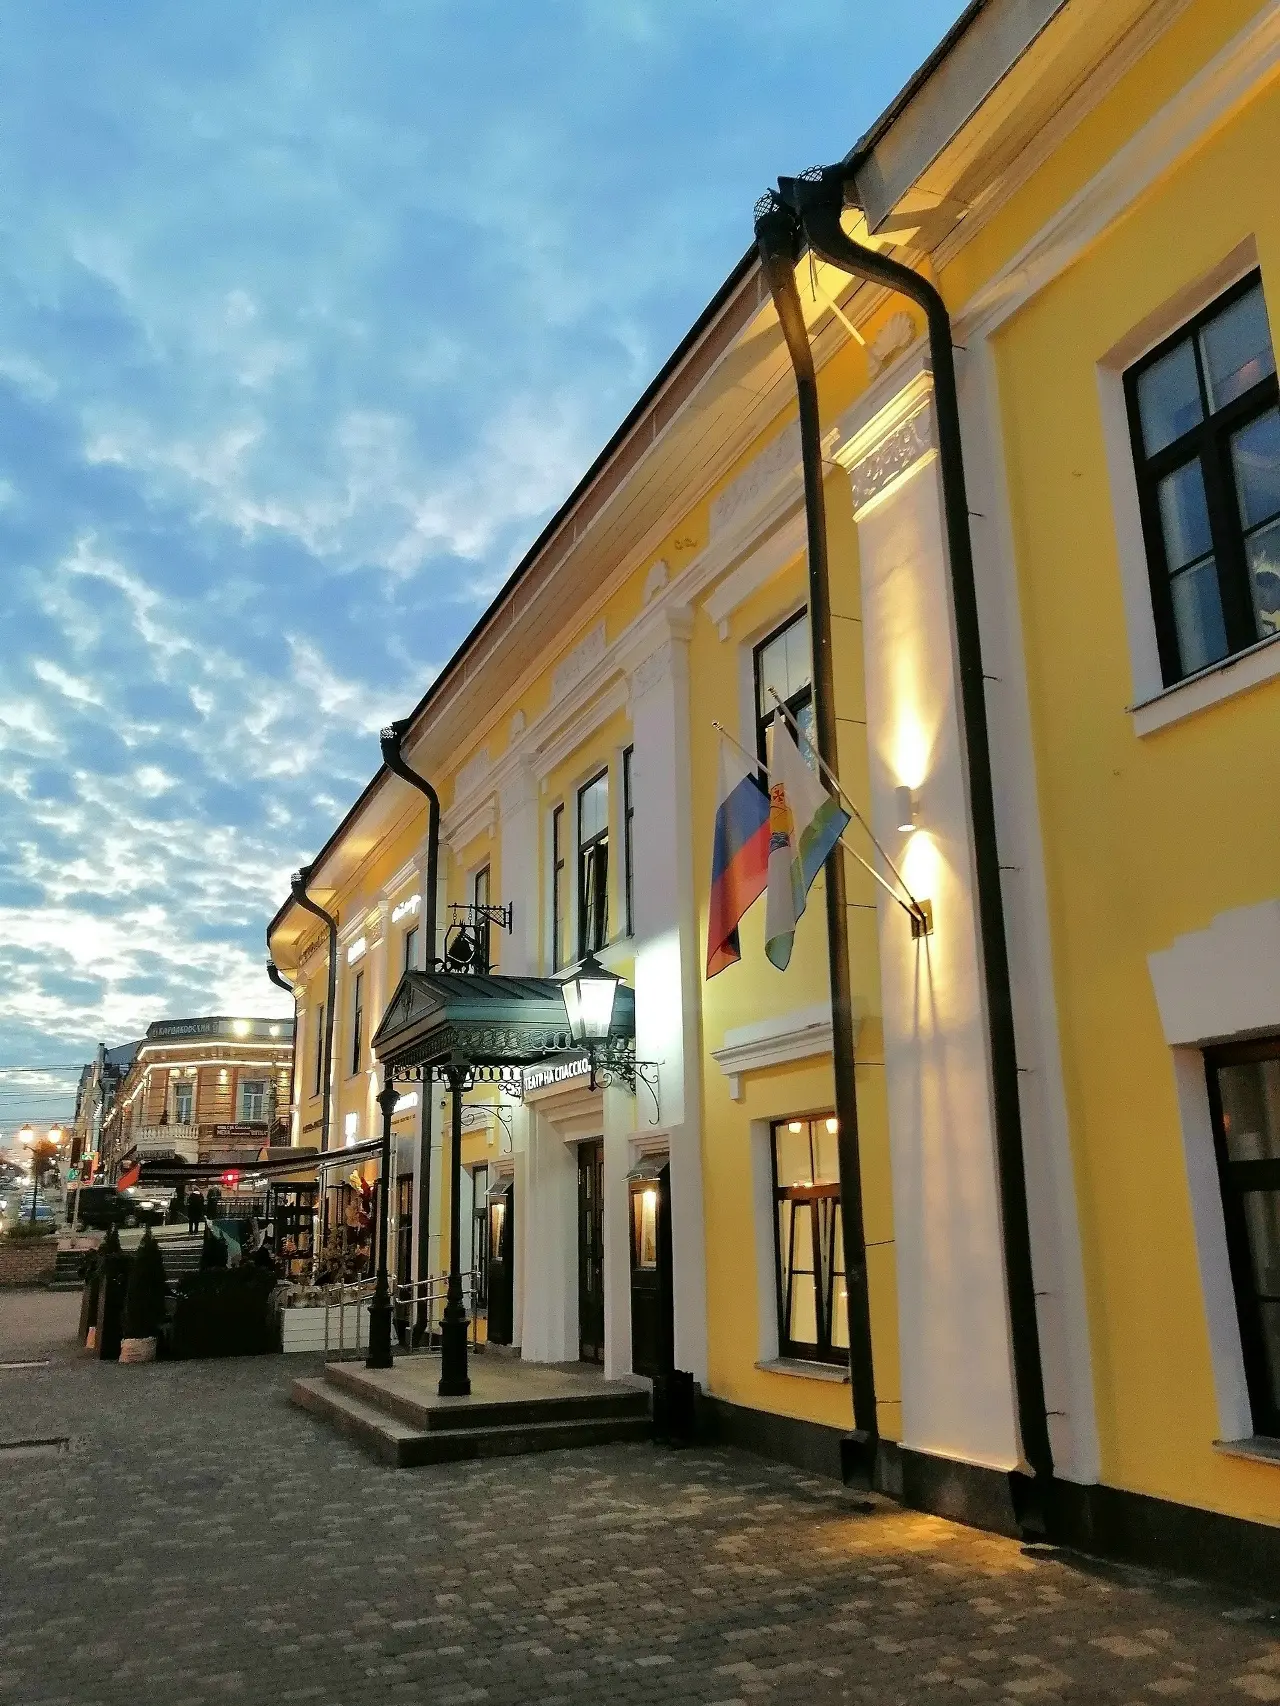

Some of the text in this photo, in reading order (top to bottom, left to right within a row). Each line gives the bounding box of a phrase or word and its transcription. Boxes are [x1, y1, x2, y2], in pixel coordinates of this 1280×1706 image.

[524, 1058, 591, 1090] ТЕАТР НА СПАССКО
